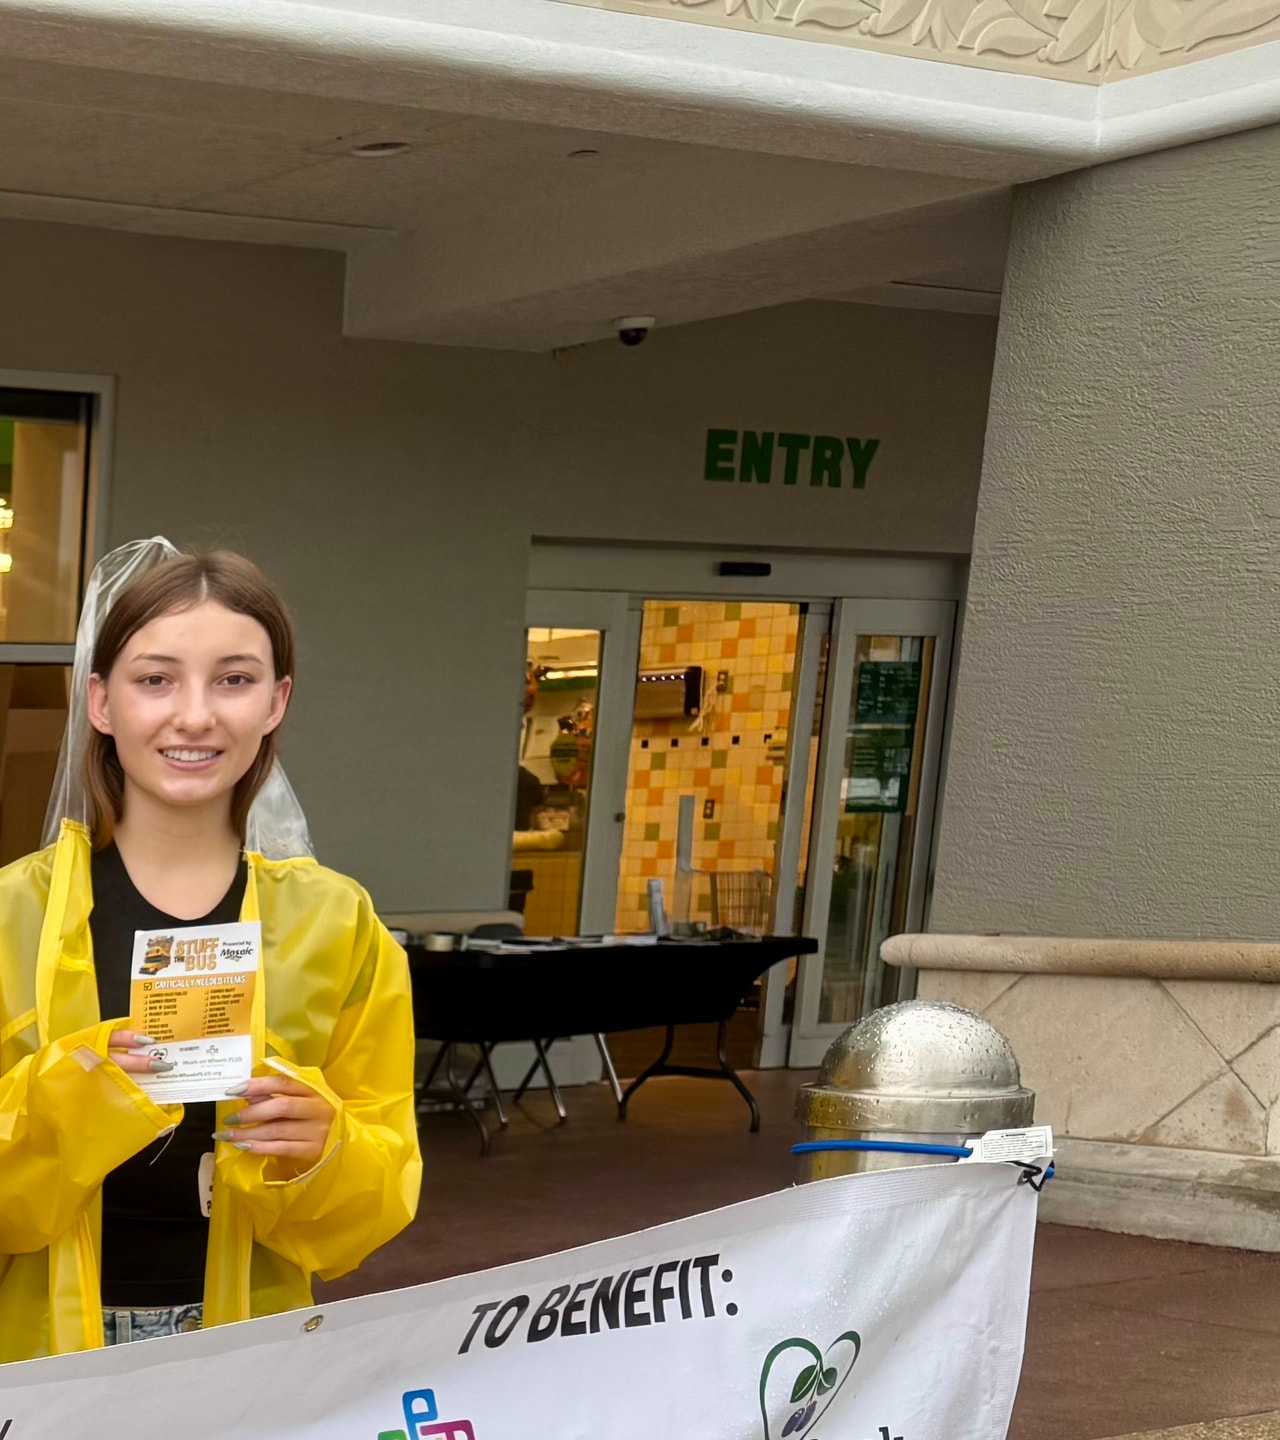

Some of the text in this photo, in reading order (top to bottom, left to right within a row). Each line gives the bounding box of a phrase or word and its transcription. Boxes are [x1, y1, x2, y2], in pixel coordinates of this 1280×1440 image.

[704, 428, 880, 489] ENTRY
[175, 937, 219, 956] STUFF
[220, 947, 253, 957] Mosaic
[185, 953, 217, 972] BUS
[458, 1252, 739, 1356] TO BENEFIT:
